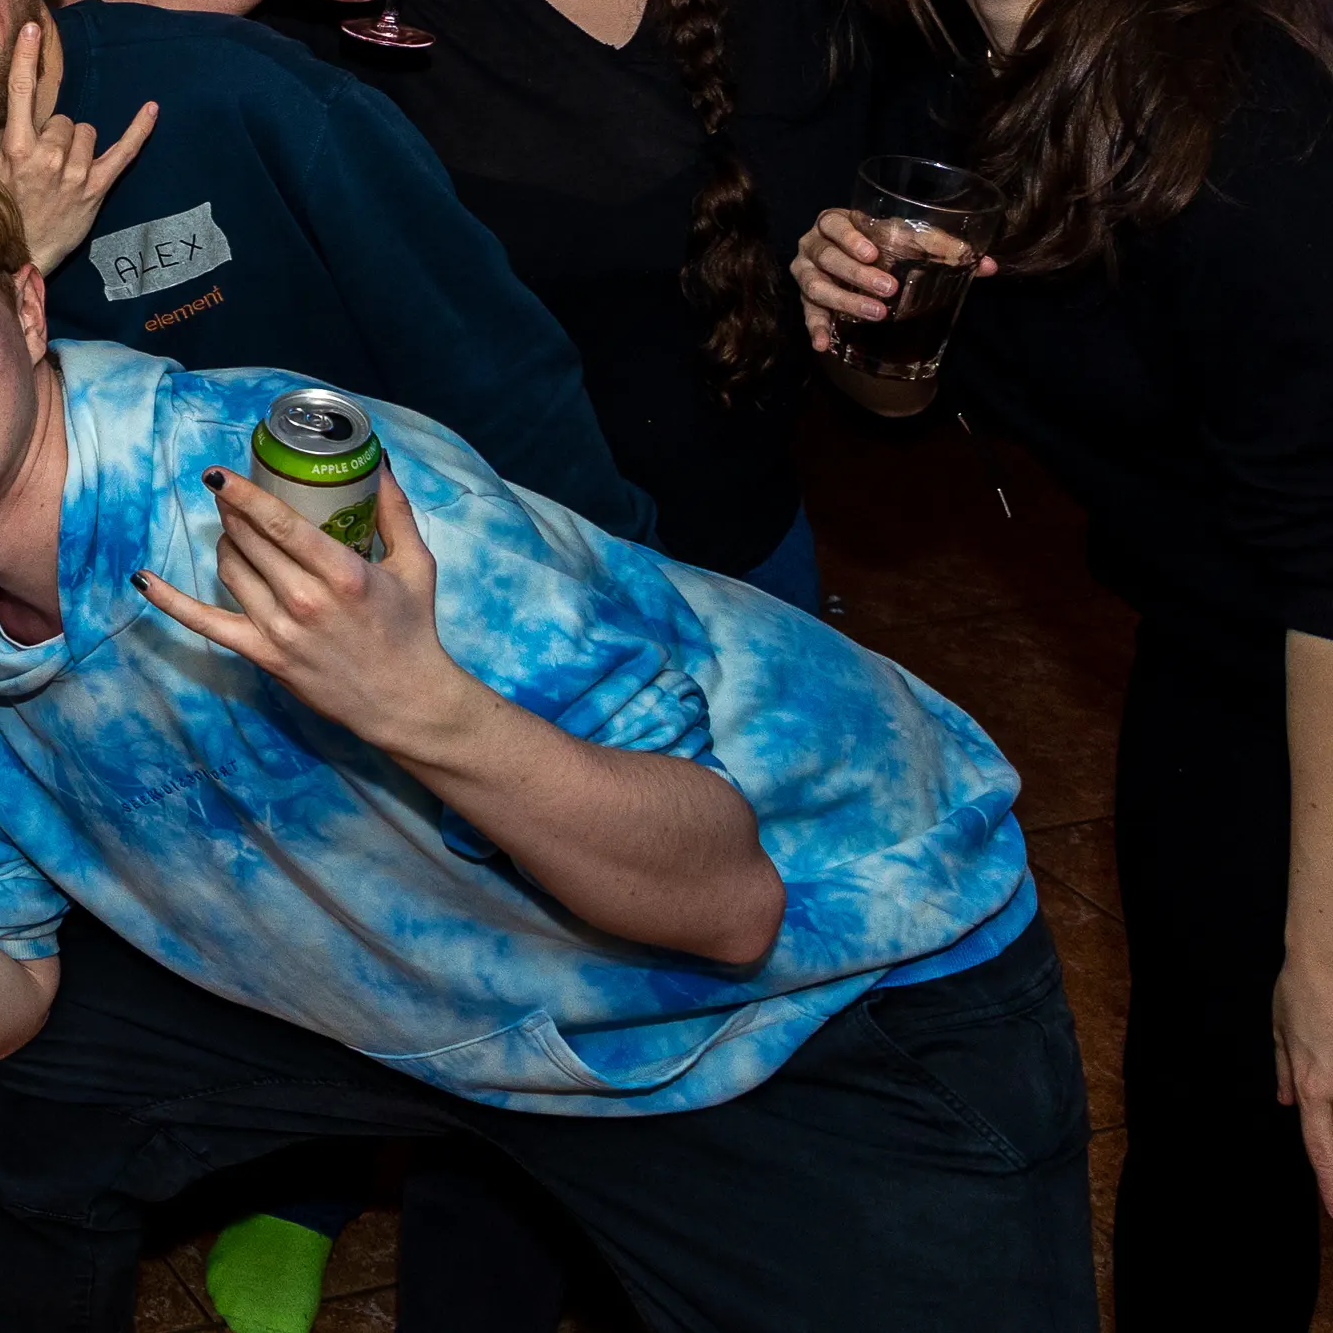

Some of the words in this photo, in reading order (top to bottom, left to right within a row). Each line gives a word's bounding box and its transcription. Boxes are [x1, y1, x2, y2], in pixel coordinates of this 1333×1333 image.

[114, 234, 203, 283] ALEX
[144, 284, 225, 332] element
[312, 462, 349, 475] APPLE
